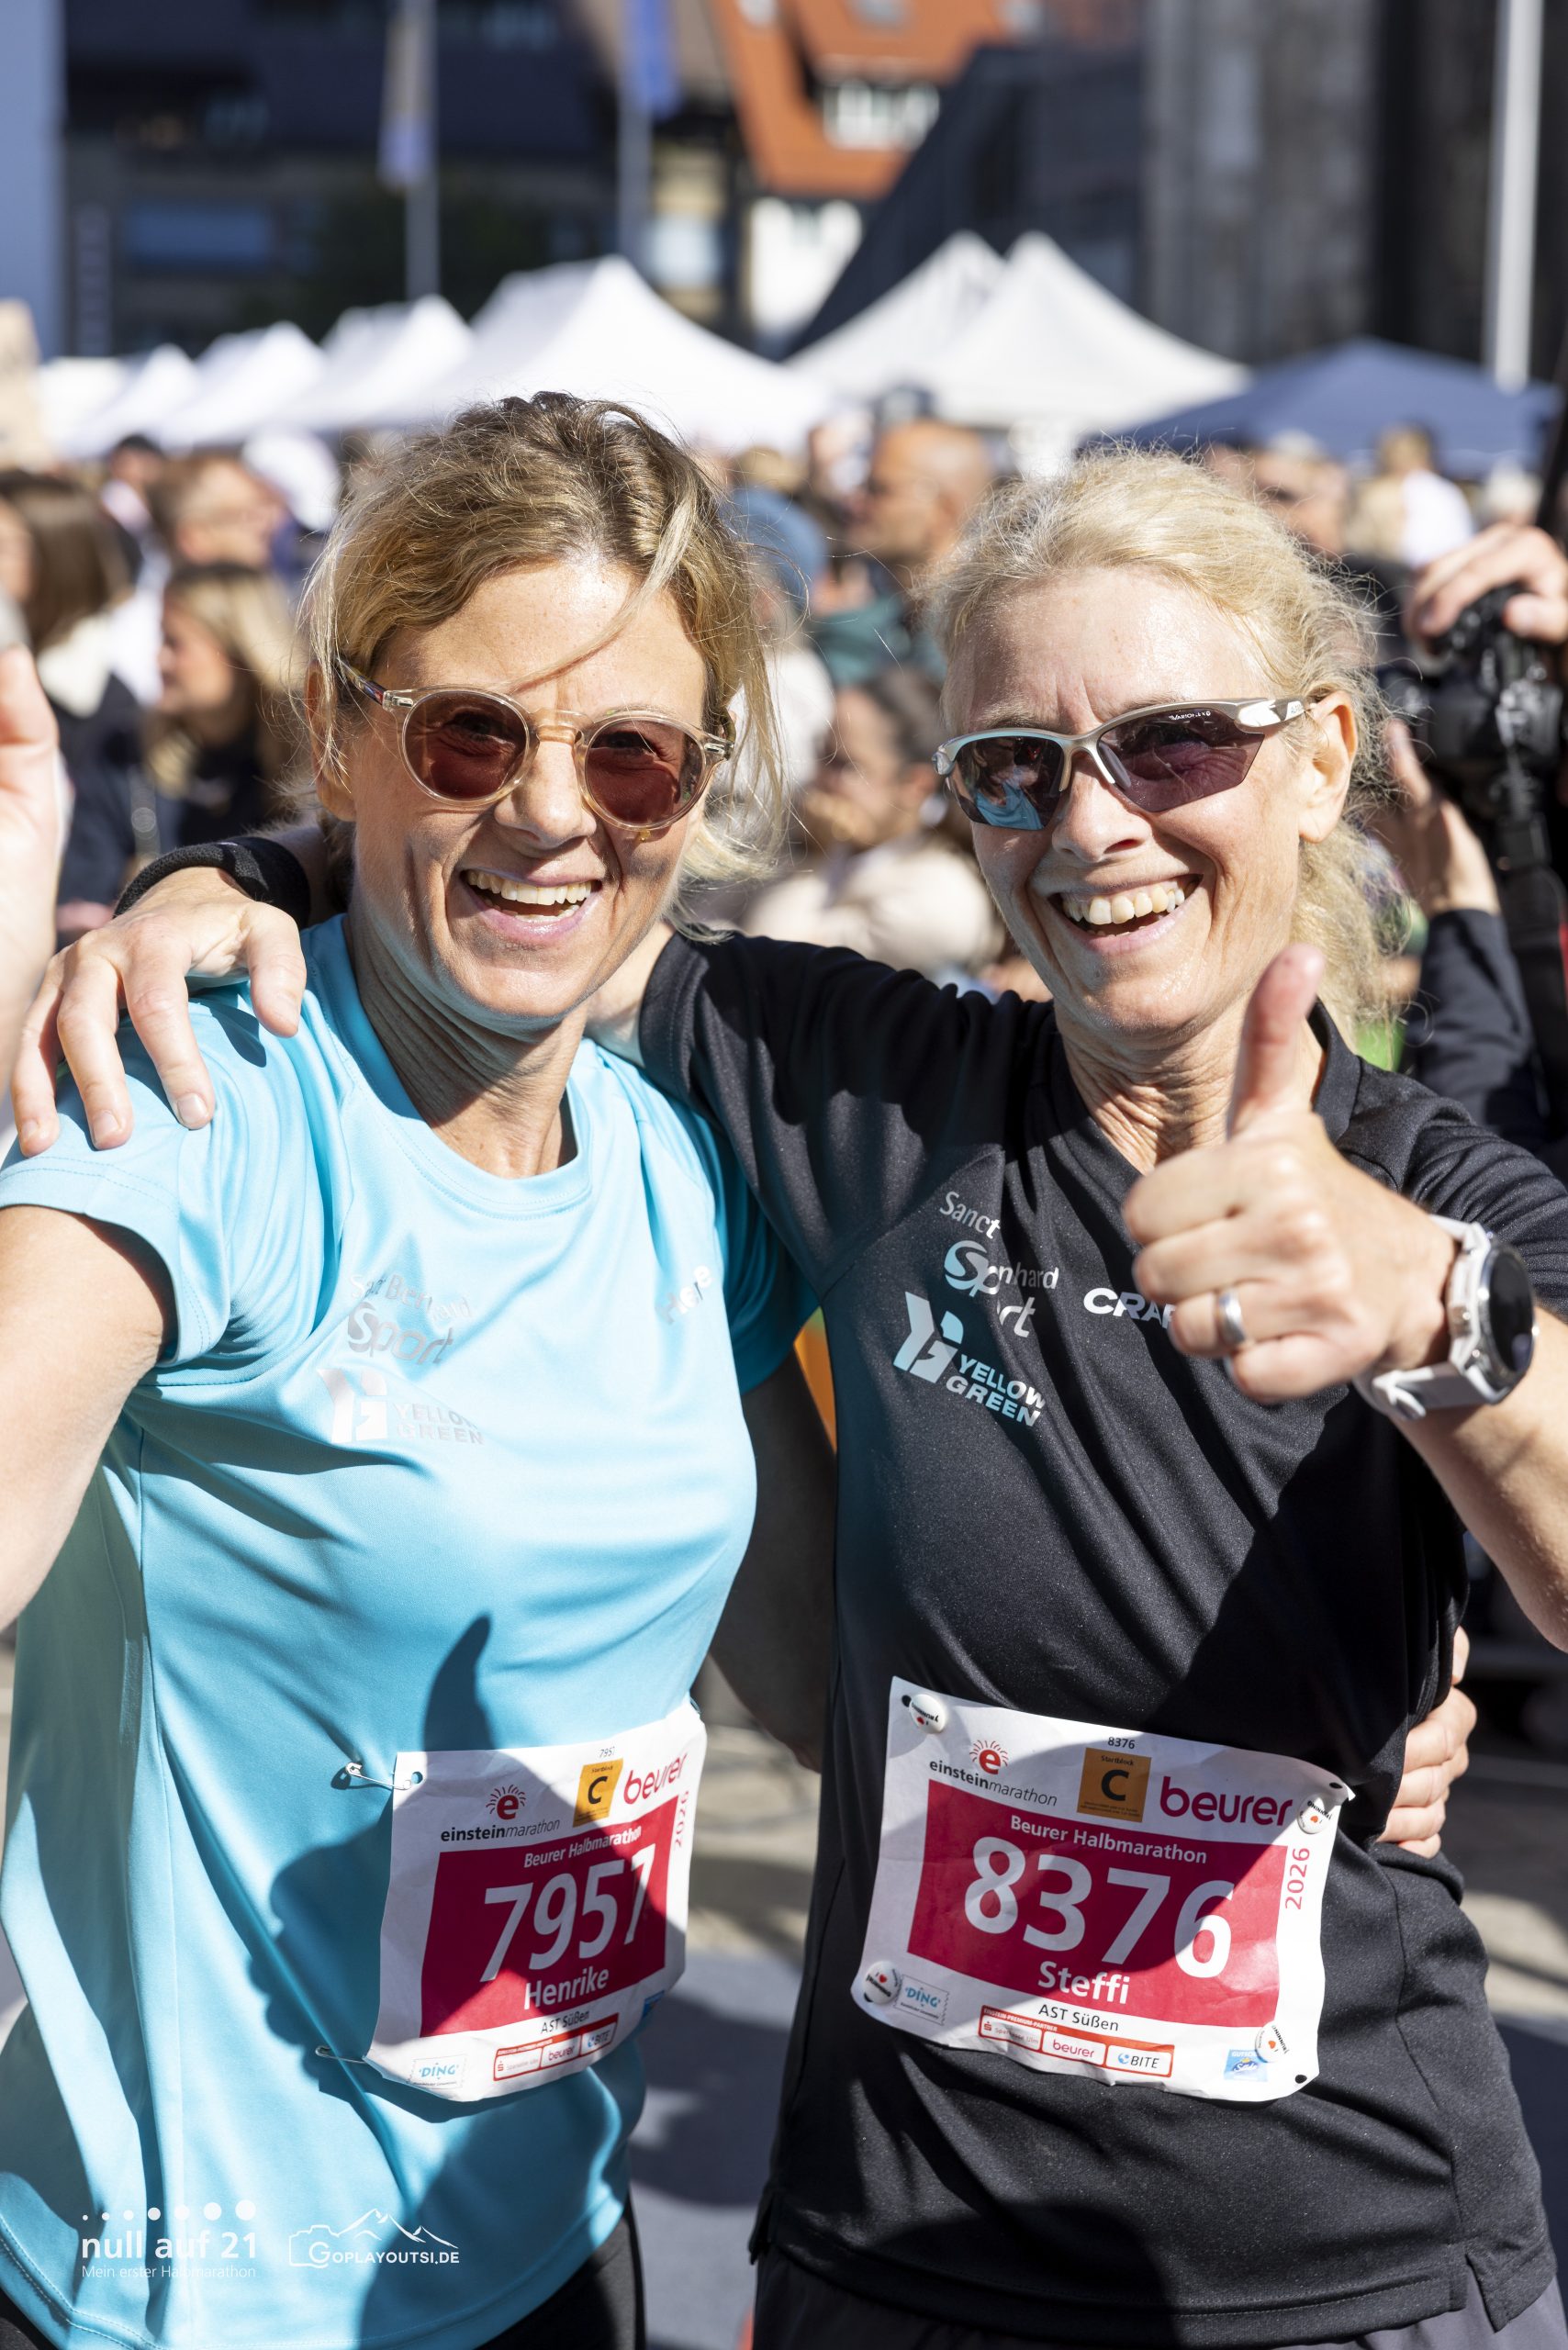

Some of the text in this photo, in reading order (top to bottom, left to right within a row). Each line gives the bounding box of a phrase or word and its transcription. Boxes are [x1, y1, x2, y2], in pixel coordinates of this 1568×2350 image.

[939, 1191, 1001, 1239] Sanct
[944, 1240, 1036, 1338] Sprt
[348, 1300, 454, 1366] Sport
[946, 1375, 1041, 1427] GREEN
[958, 1353, 1046, 1409] YELLOW
[397, 1423, 485, 1445] GREEN
[1107, 1736, 1136, 1750] 8376
[588, 1775, 608, 1805] C
[623, 1752, 688, 1805] beurer
[929, 1760, 1058, 1807] einsteinmarathon
[1101, 1769, 1130, 1802] C
[1159, 1775, 1294, 1827] beurer
[441, 1818, 561, 1842] einsteinmarathon
[523, 1825, 642, 1868] Beurer Halbmarathon
[1011, 1814, 1207, 1864] Beurer Halbmarathon
[1285, 1847, 1310, 1910] 2026
[480, 1843, 656, 1983] 7957
[964, 1836, 1236, 1979] 8376
[523, 1965, 610, 2010] Henrike
[1037, 1960, 1131, 2006] Steffi
[541, 2009, 590, 2035] AST Süßen
[1038, 2003, 1119, 2031] AST Süßen
[420, 2062, 456, 2077] DING
[548, 2044, 576, 2062] beurer
[1052, 2039, 1095, 2059] beurer
[1130, 2055, 1160, 2069] BITE
